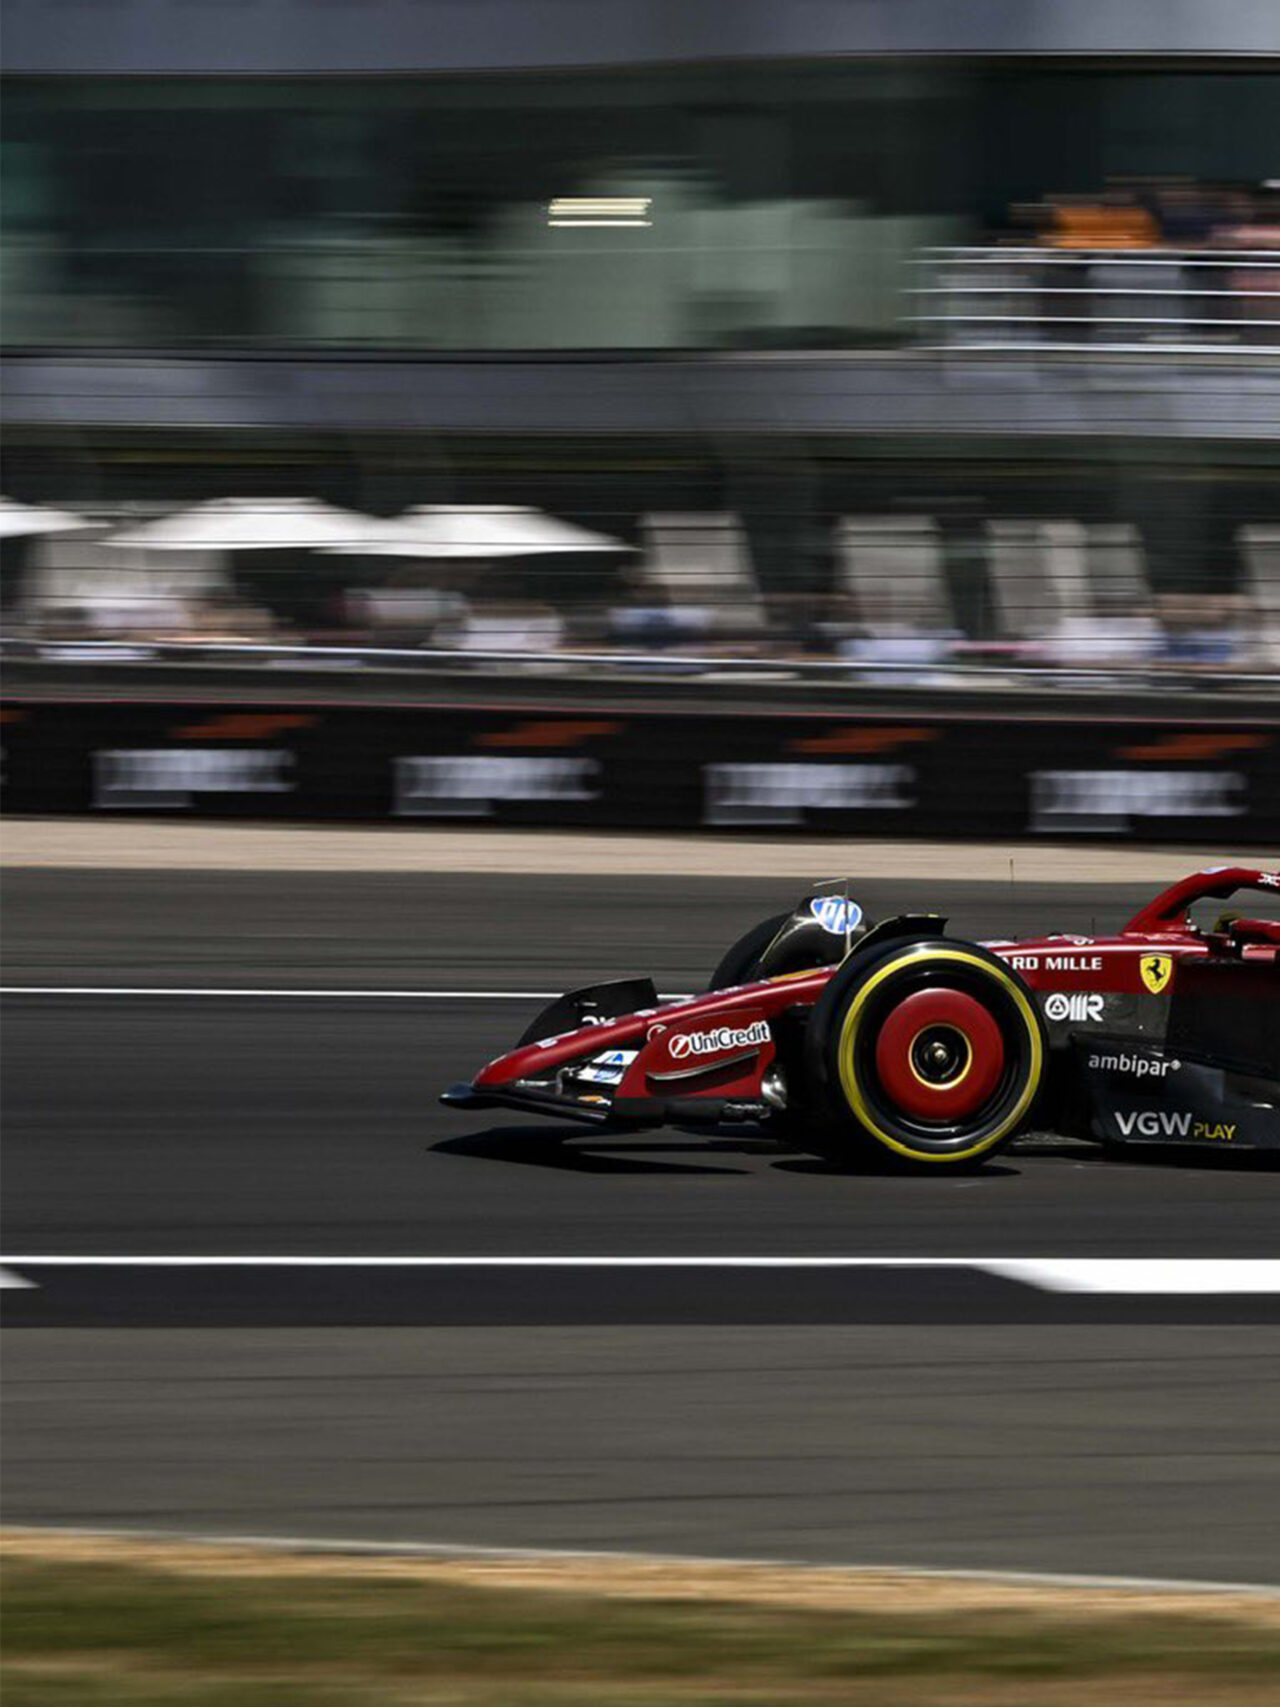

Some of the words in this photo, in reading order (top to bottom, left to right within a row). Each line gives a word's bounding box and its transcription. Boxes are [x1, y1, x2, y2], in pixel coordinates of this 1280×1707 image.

[1045, 956, 1102, 970] MILLE
[688, 1020, 771, 1054] UniCredit
[1088, 1053, 1170, 1078] ambipar
[1113, 1111, 1193, 1136] VGW
[1193, 1122, 1236, 1140] PLAY
